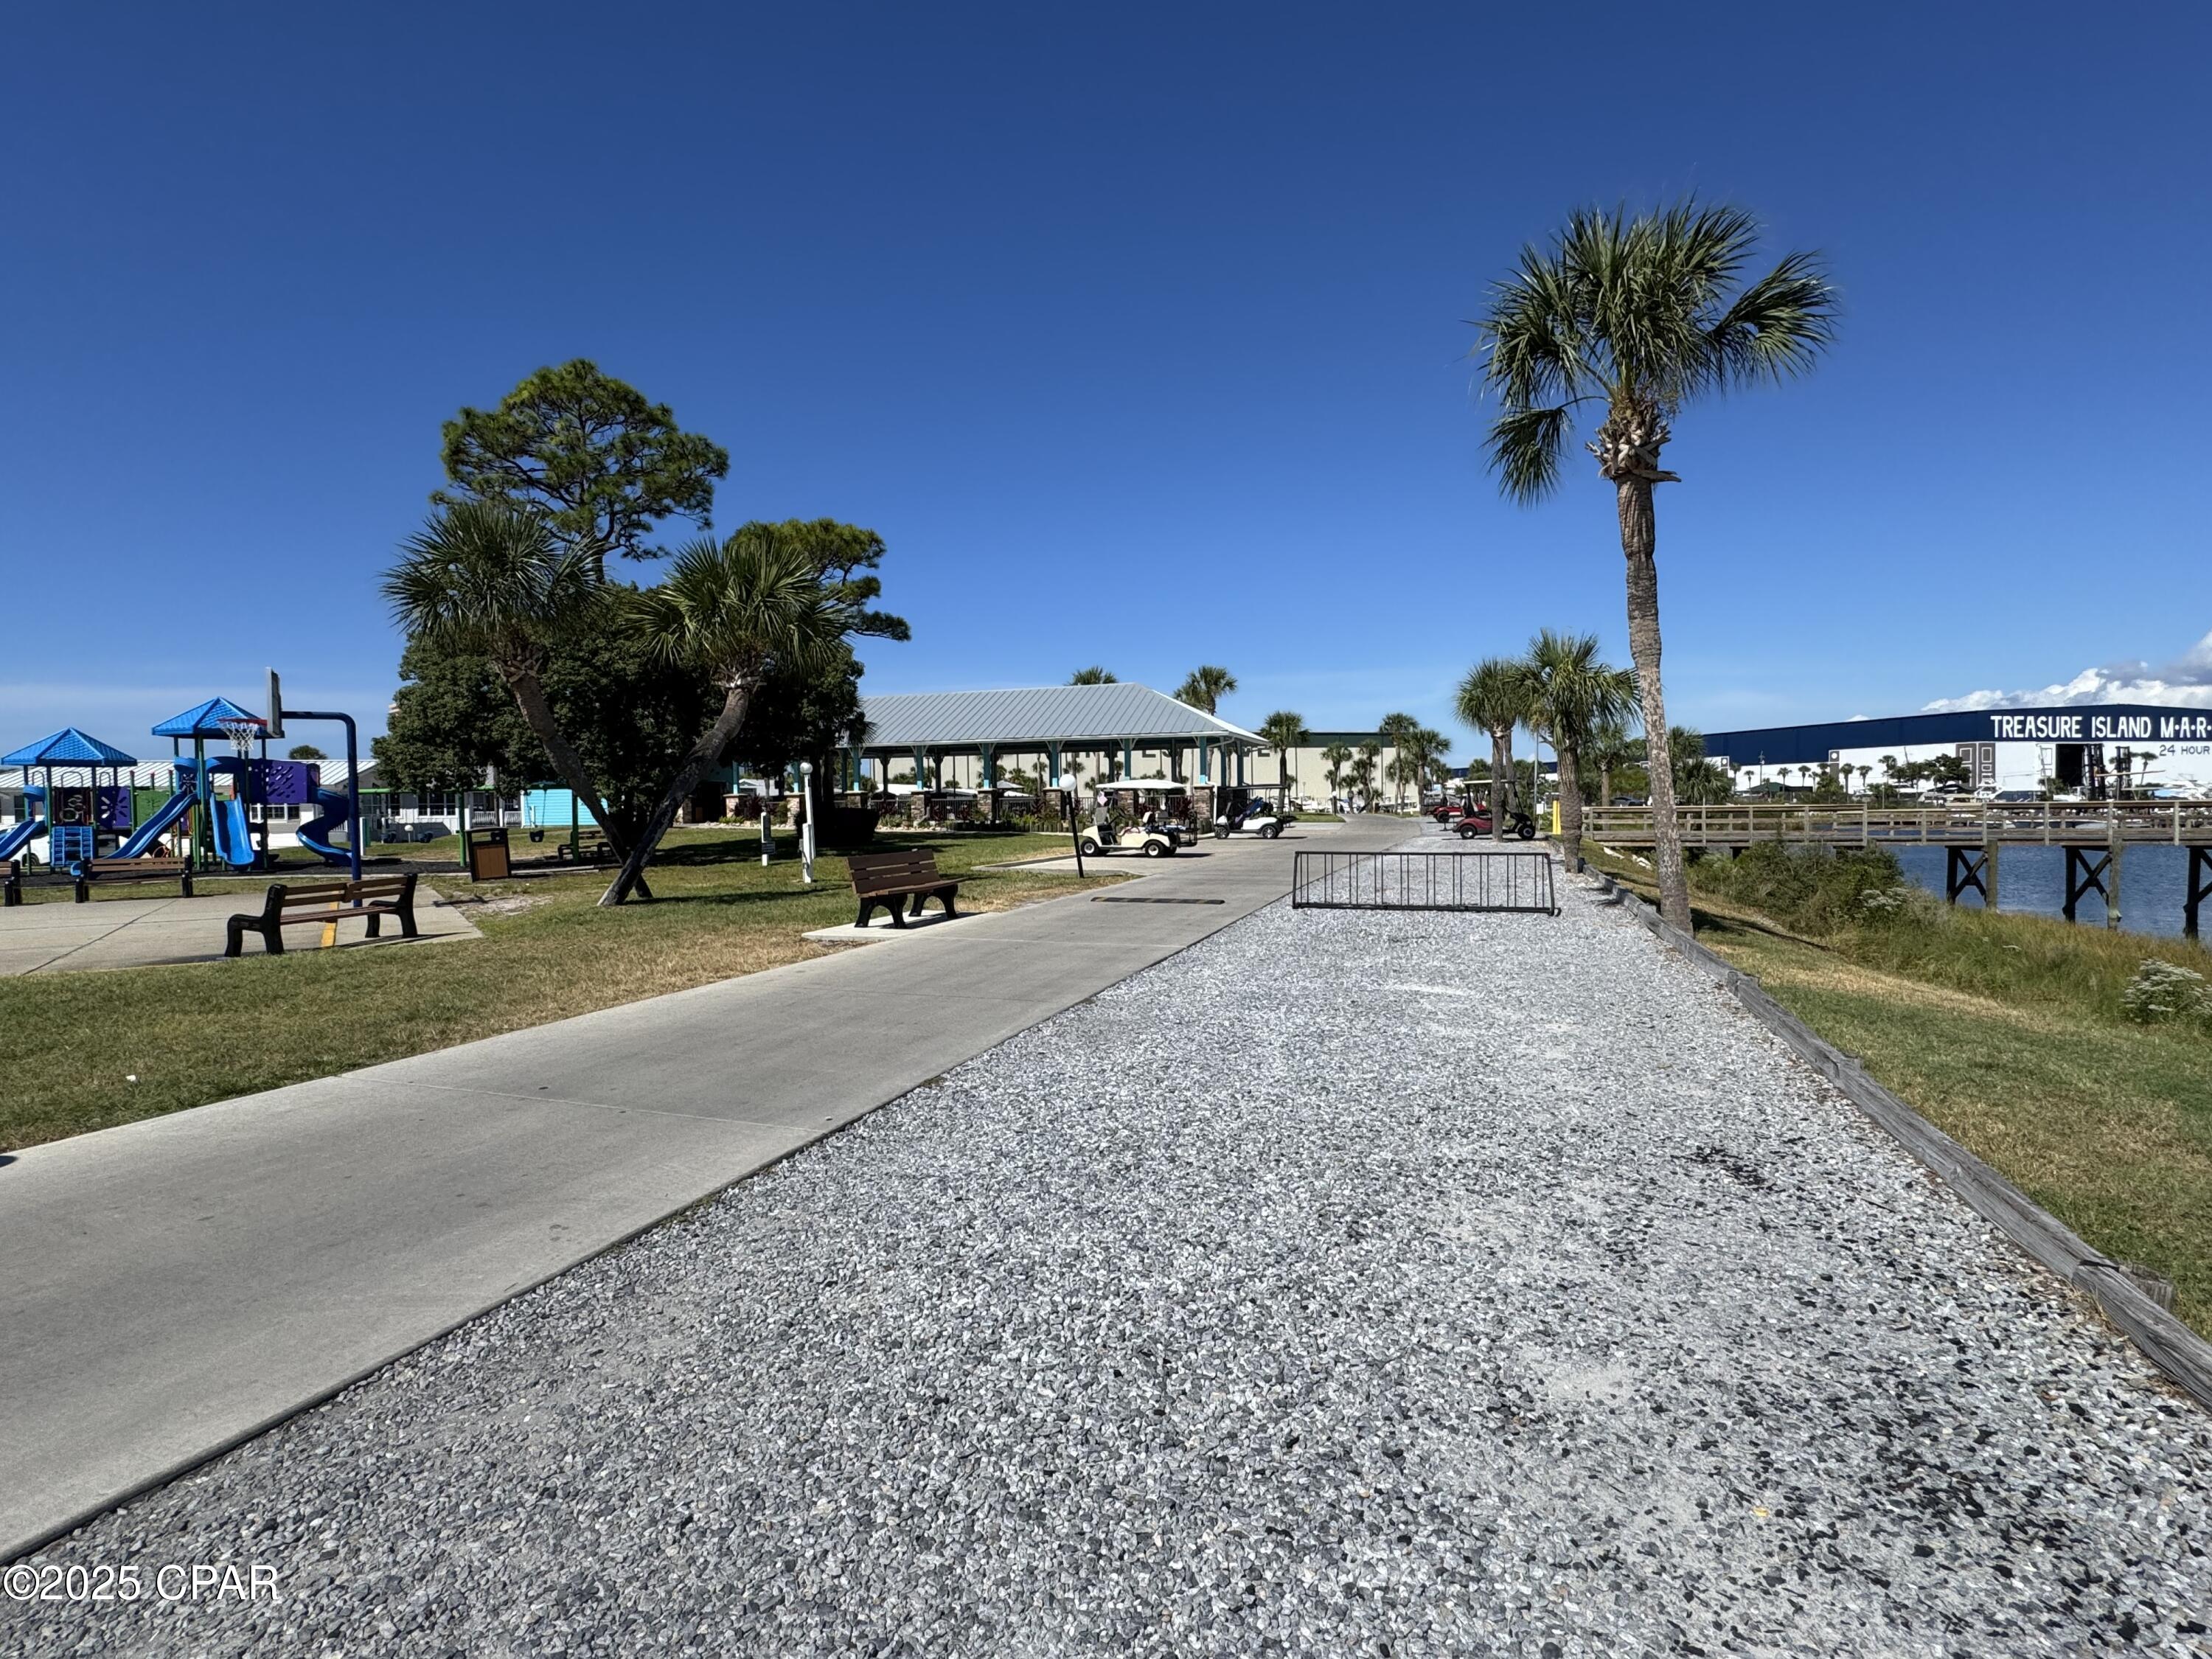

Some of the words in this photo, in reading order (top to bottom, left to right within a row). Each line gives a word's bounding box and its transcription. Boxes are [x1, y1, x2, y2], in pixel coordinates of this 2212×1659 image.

[1990, 716, 2082, 738] TREASURE
[2092, 717, 2152, 738] ISLAND
[2159, 744, 2175, 756] 24
[2181, 745, 2211, 754] HOUR
